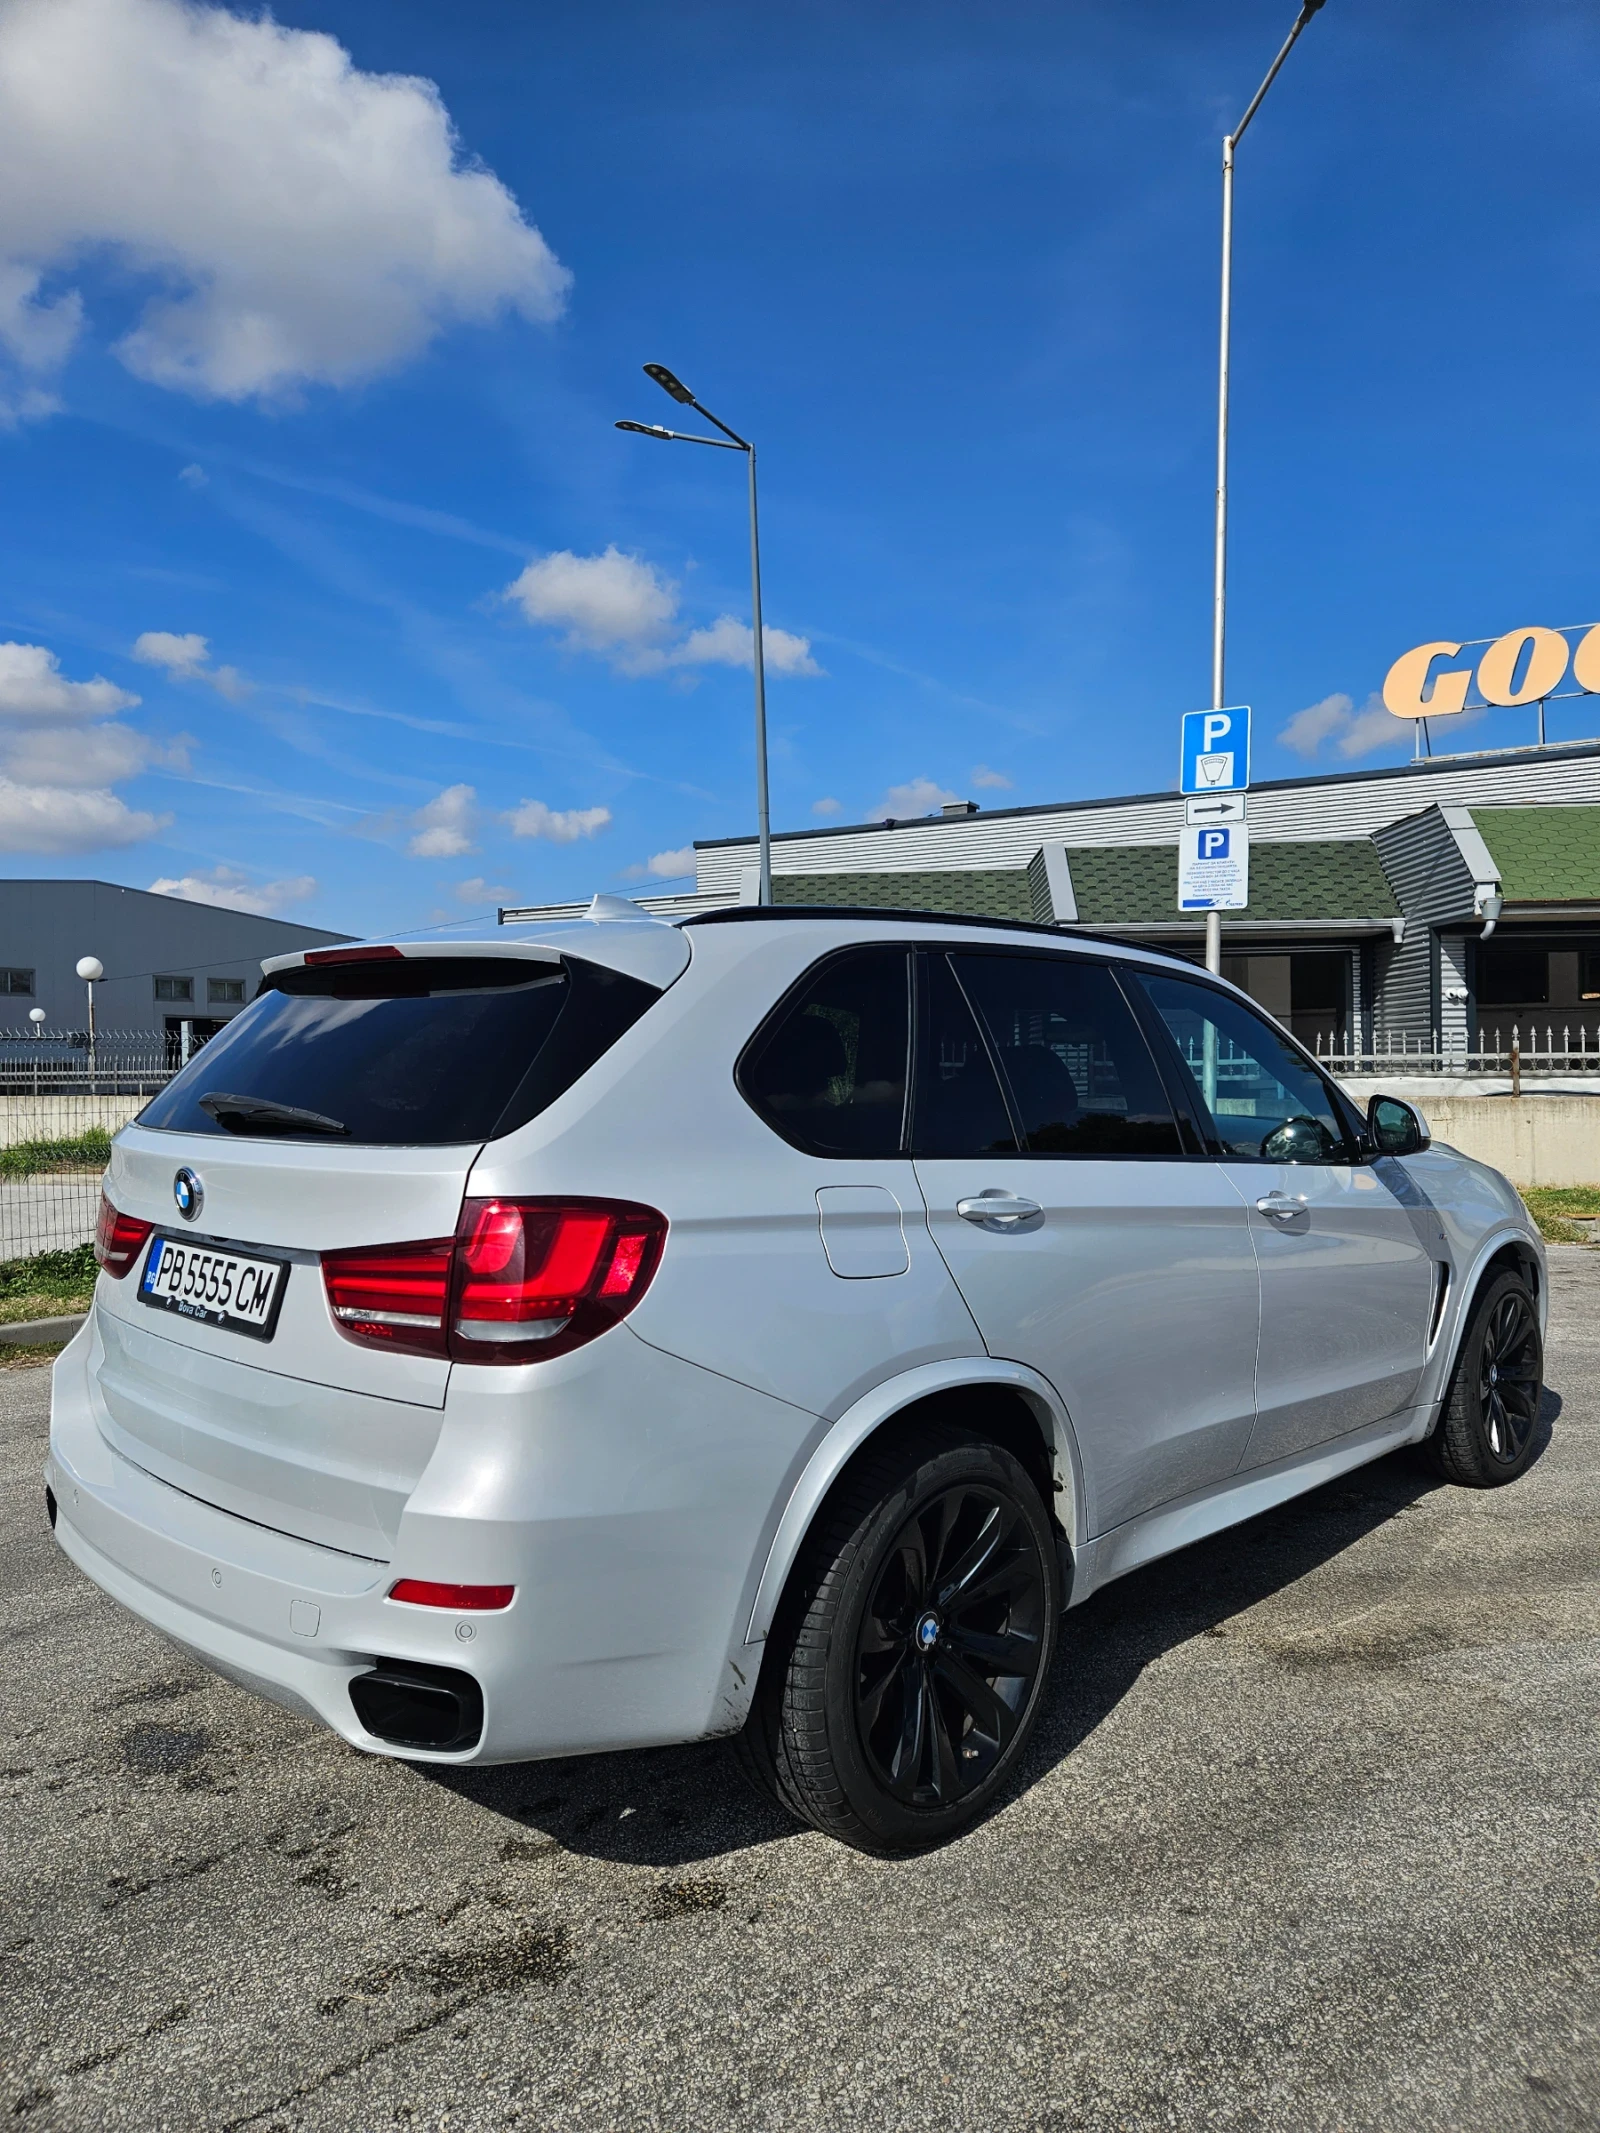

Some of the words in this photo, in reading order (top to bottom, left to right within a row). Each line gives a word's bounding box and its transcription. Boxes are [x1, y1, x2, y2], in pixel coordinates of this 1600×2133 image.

[1203, 713, 1231, 752] P
[1205, 832, 1225, 857] P
[146, 1271, 156, 1284] BG
[156, 1247, 186, 1292] PB
[183, 1253, 237, 1306] 5555
[235, 1266, 274, 1317] CM
[178, 1301, 194, 1315] Bova
[194, 1305, 208, 1319] Car
